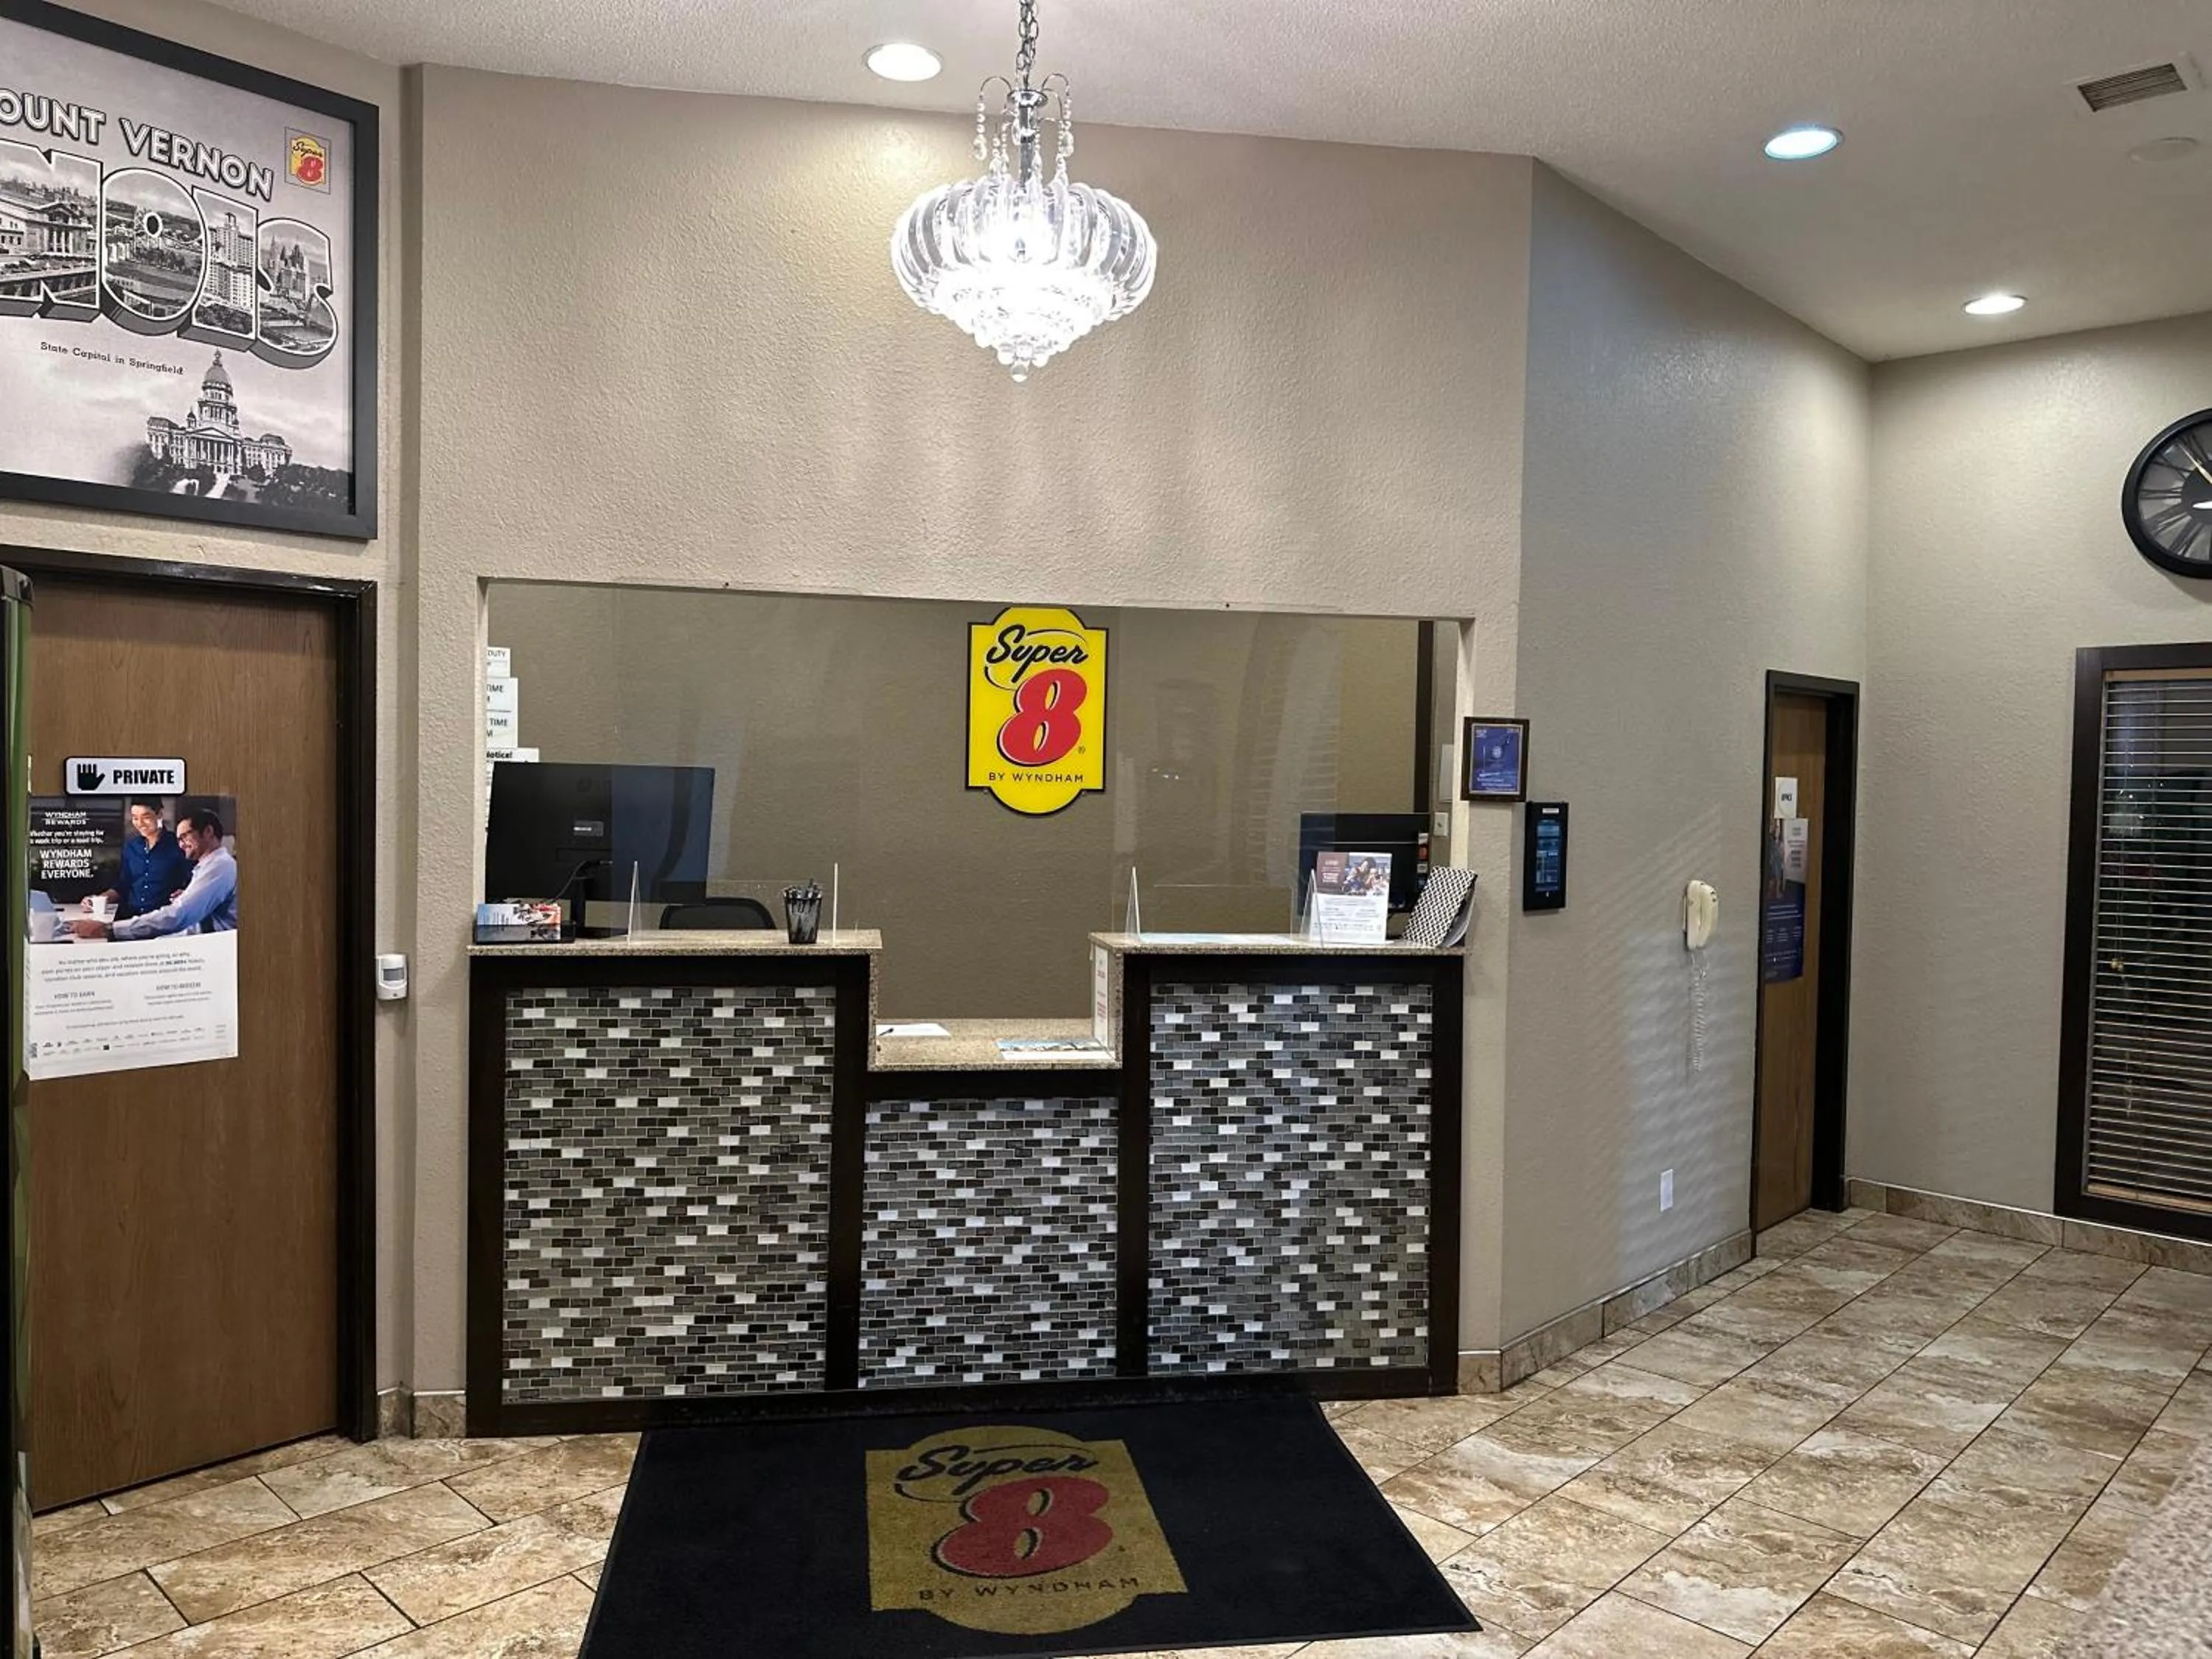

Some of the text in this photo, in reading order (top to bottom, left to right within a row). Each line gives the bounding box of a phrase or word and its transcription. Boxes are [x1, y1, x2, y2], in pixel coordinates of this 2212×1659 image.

[119, 117, 274, 202] VERNON
[296, 156, 324, 184] 8
[41, 341, 68, 354] State
[115, 355, 125, 364] in
[129, 358, 184, 375] Springfield
[985, 624, 1089, 683] Super
[490, 718, 507, 726] TIME
[997, 668, 1088, 768] 8
[113, 769, 175, 785] PRIVATE
[989, 772, 1084, 782] BY WYNDHAM
[40, 849, 92, 859] WYNDHAM
[44, 859, 89, 869] REWARDS
[41, 869, 94, 880] EVERYONE.
[895, 1444, 1099, 1496] Super
[931, 1475, 1113, 1579] 8
[919, 1576, 1139, 1601] BY WYNDHAM
